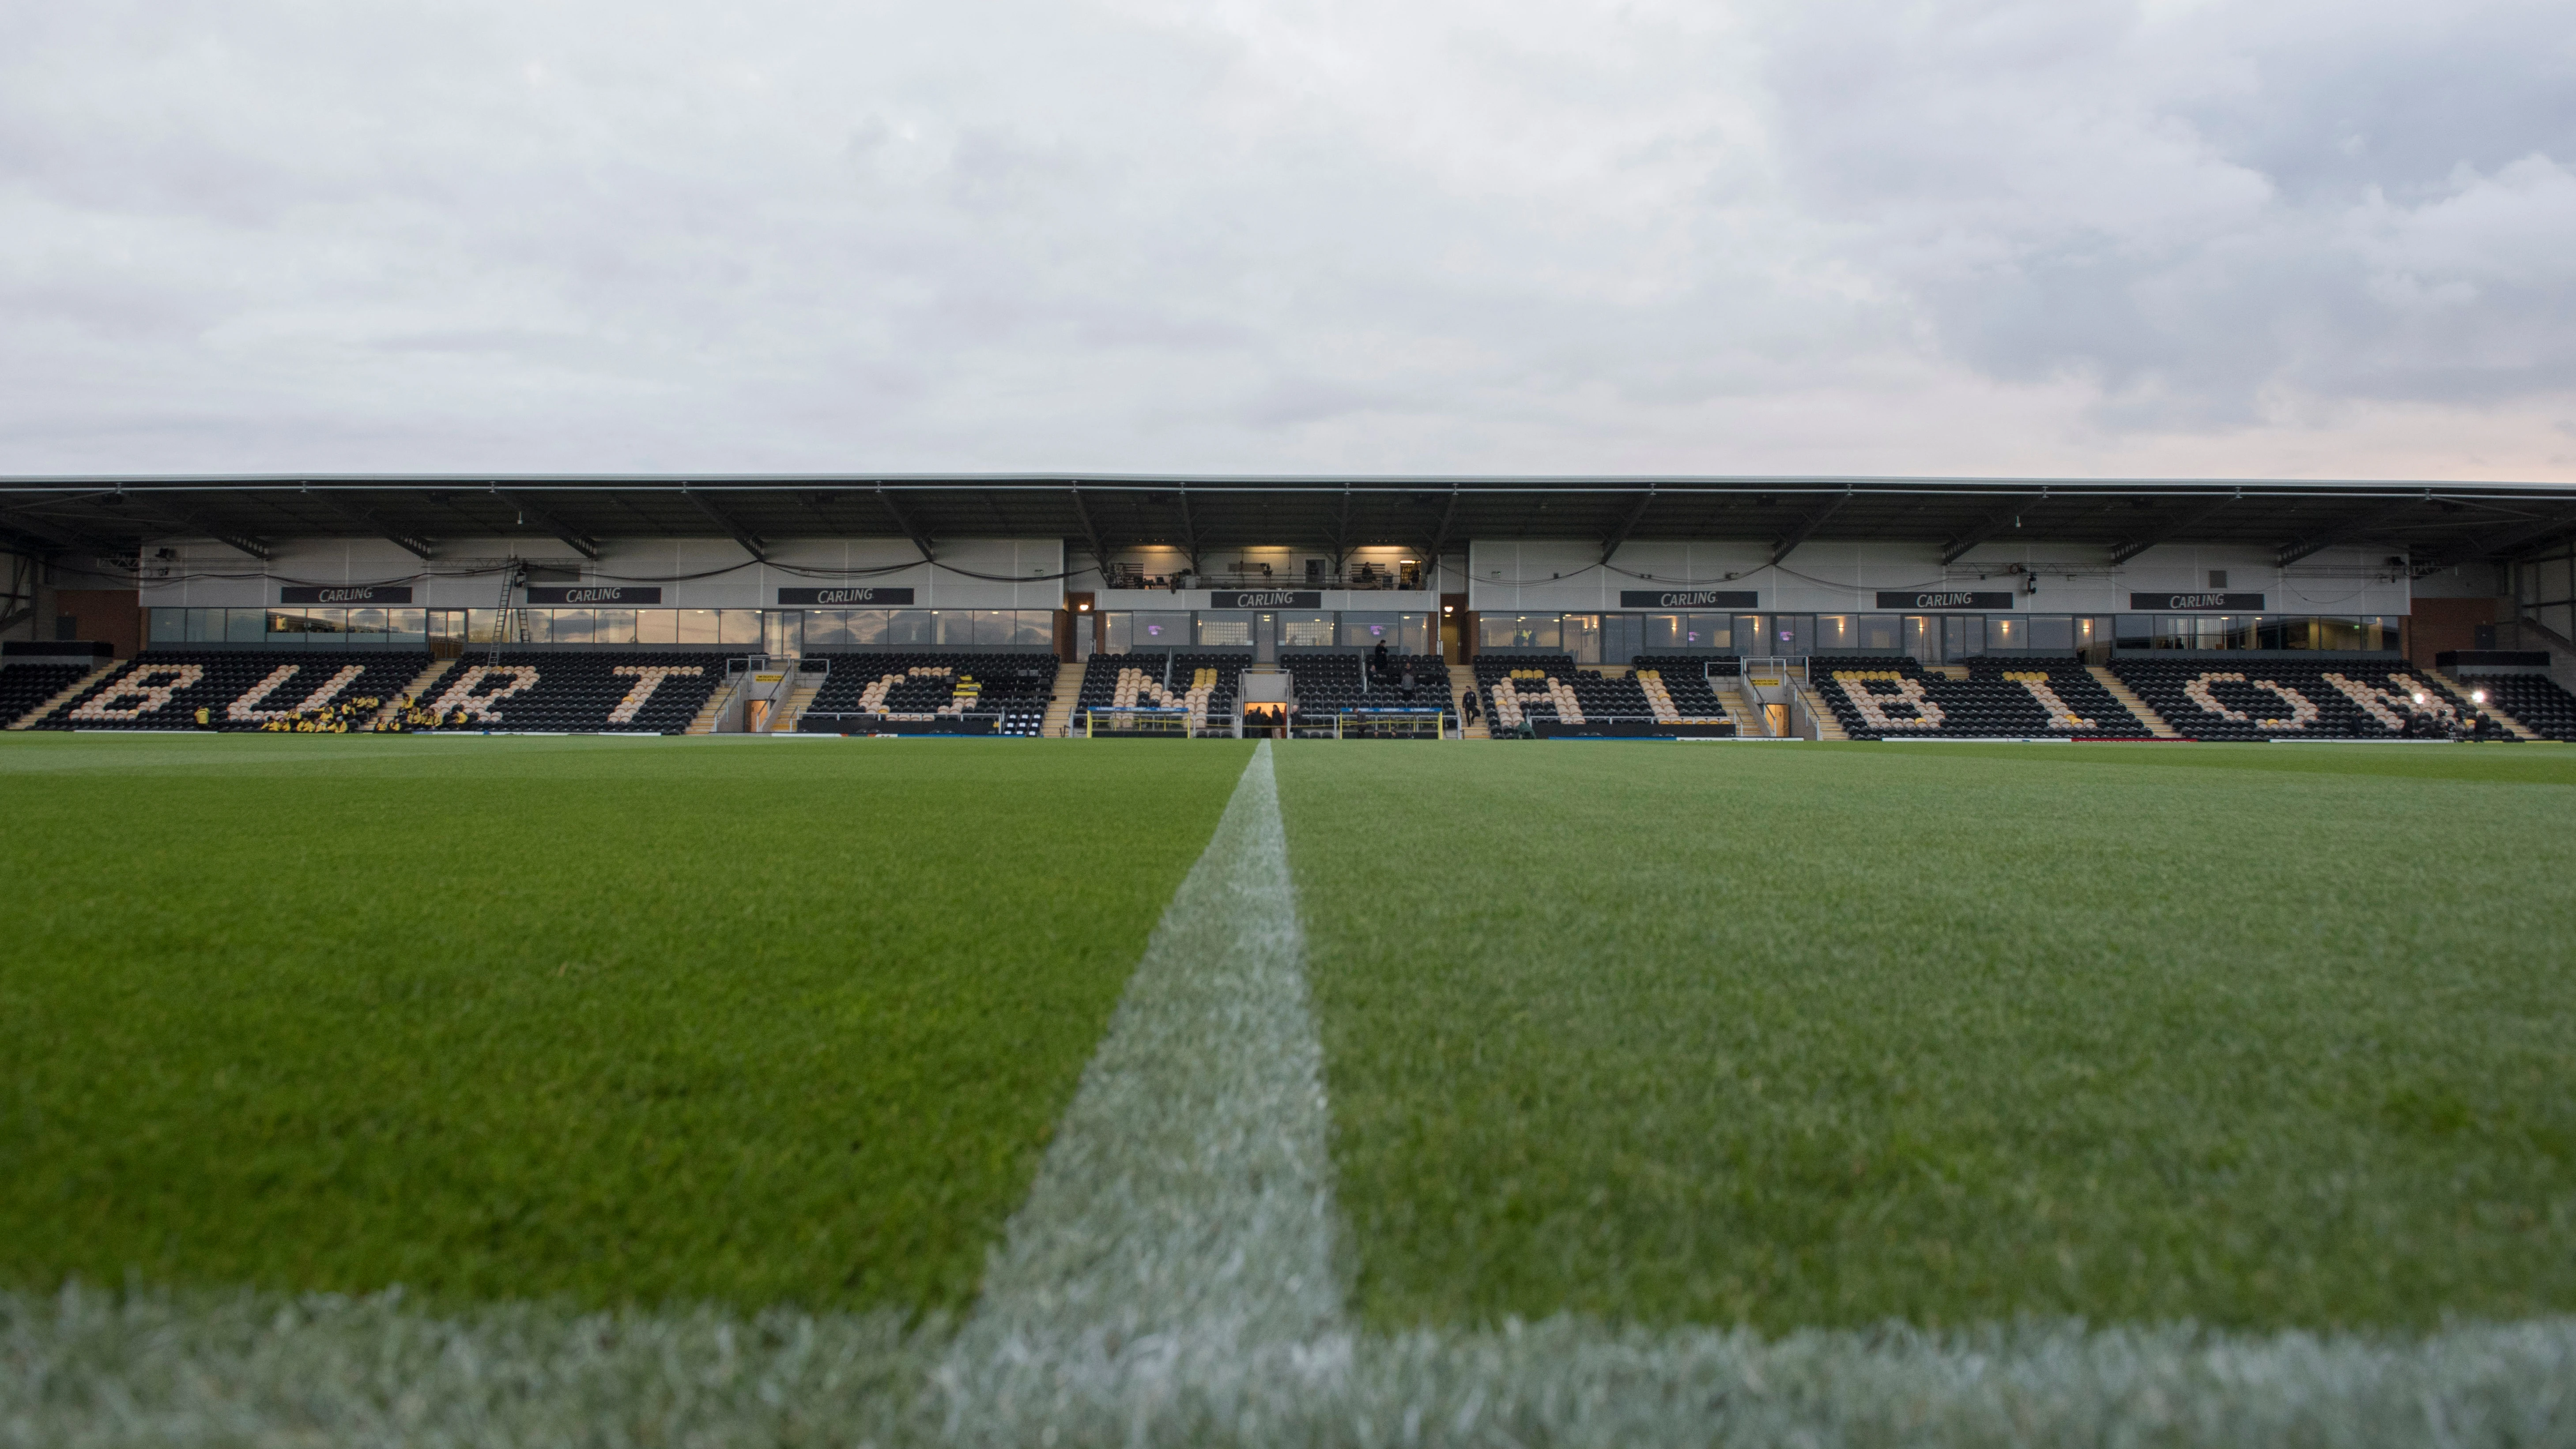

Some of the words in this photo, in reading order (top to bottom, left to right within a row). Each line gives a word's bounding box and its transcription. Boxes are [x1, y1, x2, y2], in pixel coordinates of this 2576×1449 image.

[319, 587, 373, 602] CARLING
[566, 587, 621, 602] CARLING
[818, 588, 873, 603] CARLING
[1237, 592, 1293, 607] CARLING
[1661, 591, 1716, 606] CARLING
[1917, 592, 1972, 607] CARLING
[2170, 594, 2224, 609] CARLING
